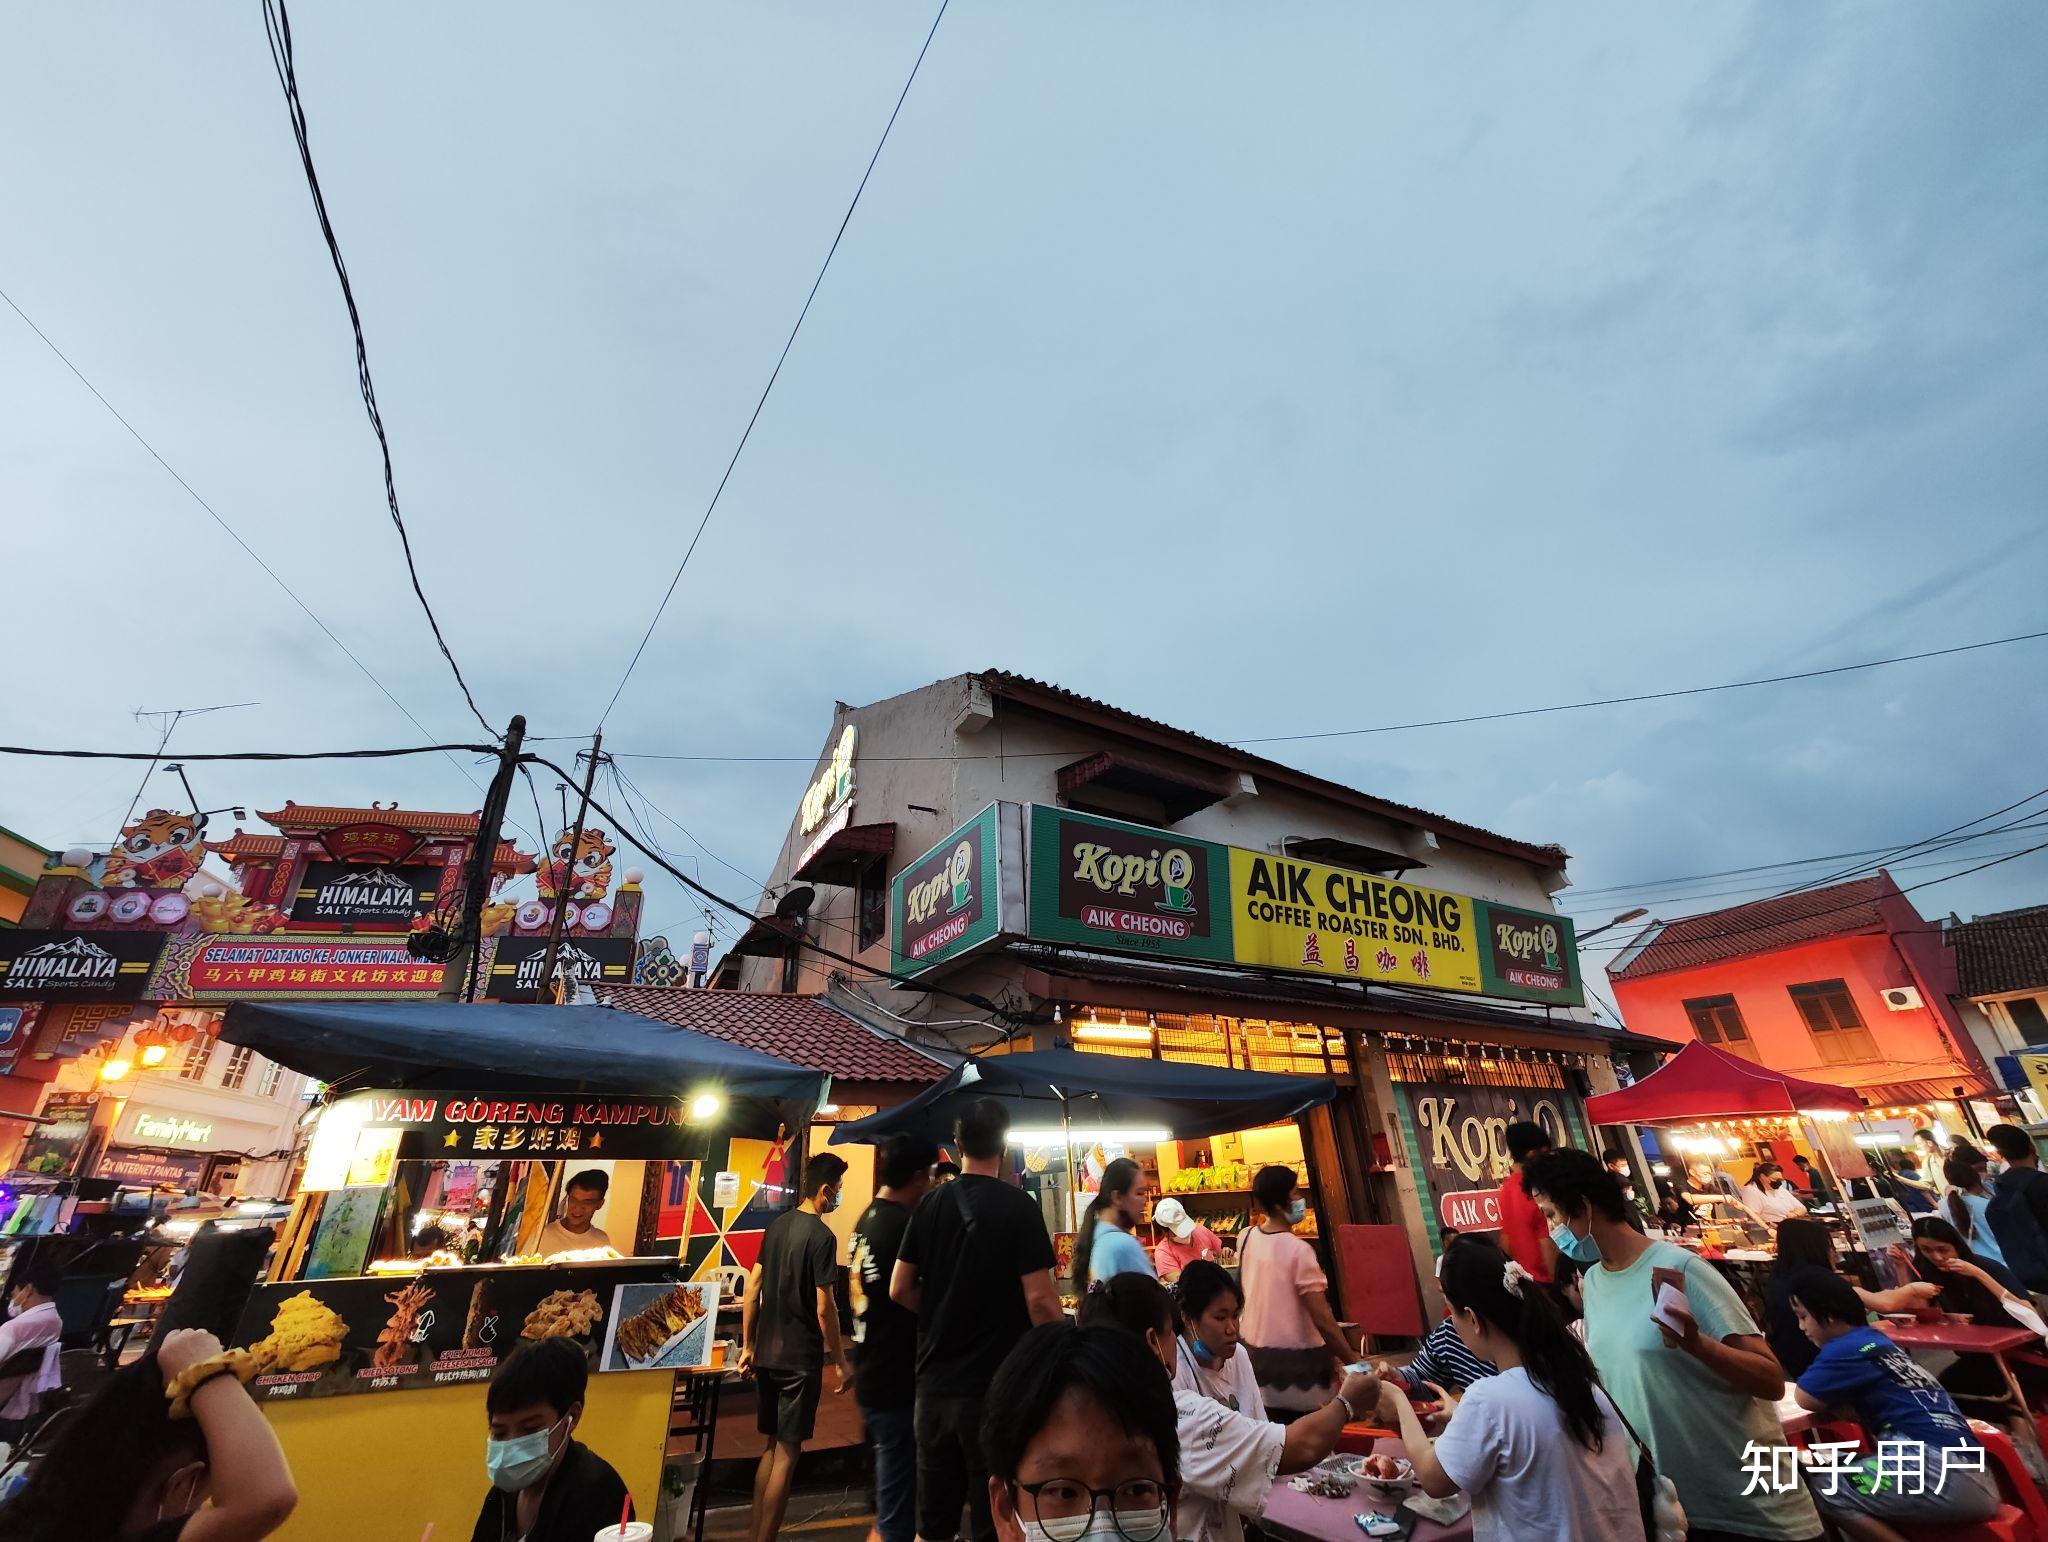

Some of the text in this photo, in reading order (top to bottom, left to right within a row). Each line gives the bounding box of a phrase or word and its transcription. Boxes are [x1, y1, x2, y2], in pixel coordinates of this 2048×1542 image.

[318, 886, 413, 906] HIMALAYA
[1247, 857, 1461, 932] AIK CHEONG
[314, 905, 352, 915] SALT
[352, 906, 380, 915] Sports
[1087, 909, 1185, 937] AIK CHEONG
[1247, 900, 1465, 952] COFFEE ROASTER SDN. BHD.
[912, 917, 966, 959] AIK CHEONG
[1115, 934, 1161, 950] Since 1955
[204, 948, 262, 963] SELAMAT
[263, 949, 311, 964] DATANG
[312, 949, 329, 964] KE
[330, 949, 378, 965] JONKER
[380, 949, 412, 965] WALK
[1301, 932, 1431, 981] 益昌咖啡
[9, 957, 117, 978] HIMALAYA
[203, 968, 445, 983] 马六甲鸡场街文化坊欢迎您
[517, 961, 601, 979] HIAAYA
[4, 978, 47, 989] SALT
[45, 979, 79, 989] Sports
[516, 979, 540, 989] SAL
[1509, 971, 1559, 989] AIK CHEONG
[368, 1098, 438, 1123] YAM
[444, 1099, 564, 1124] GORENG
[134, 1113, 212, 1145] FamilyMart
[472, 1125, 582, 1151] 家乡炸鸡
[114, 1161, 153, 1177] INTERNET
[154, 1164, 183, 1178] PANTAS
[1452, 1199, 1482, 1227] AIK
[463, 1346, 493, 1358] JUMBO
[356, 1364, 419, 1378] FRIED SOTONG
[429, 1356, 497, 1371] CHEESE SAUSAGE
[255, 1372, 322, 1385] CHICKEN CHOP
